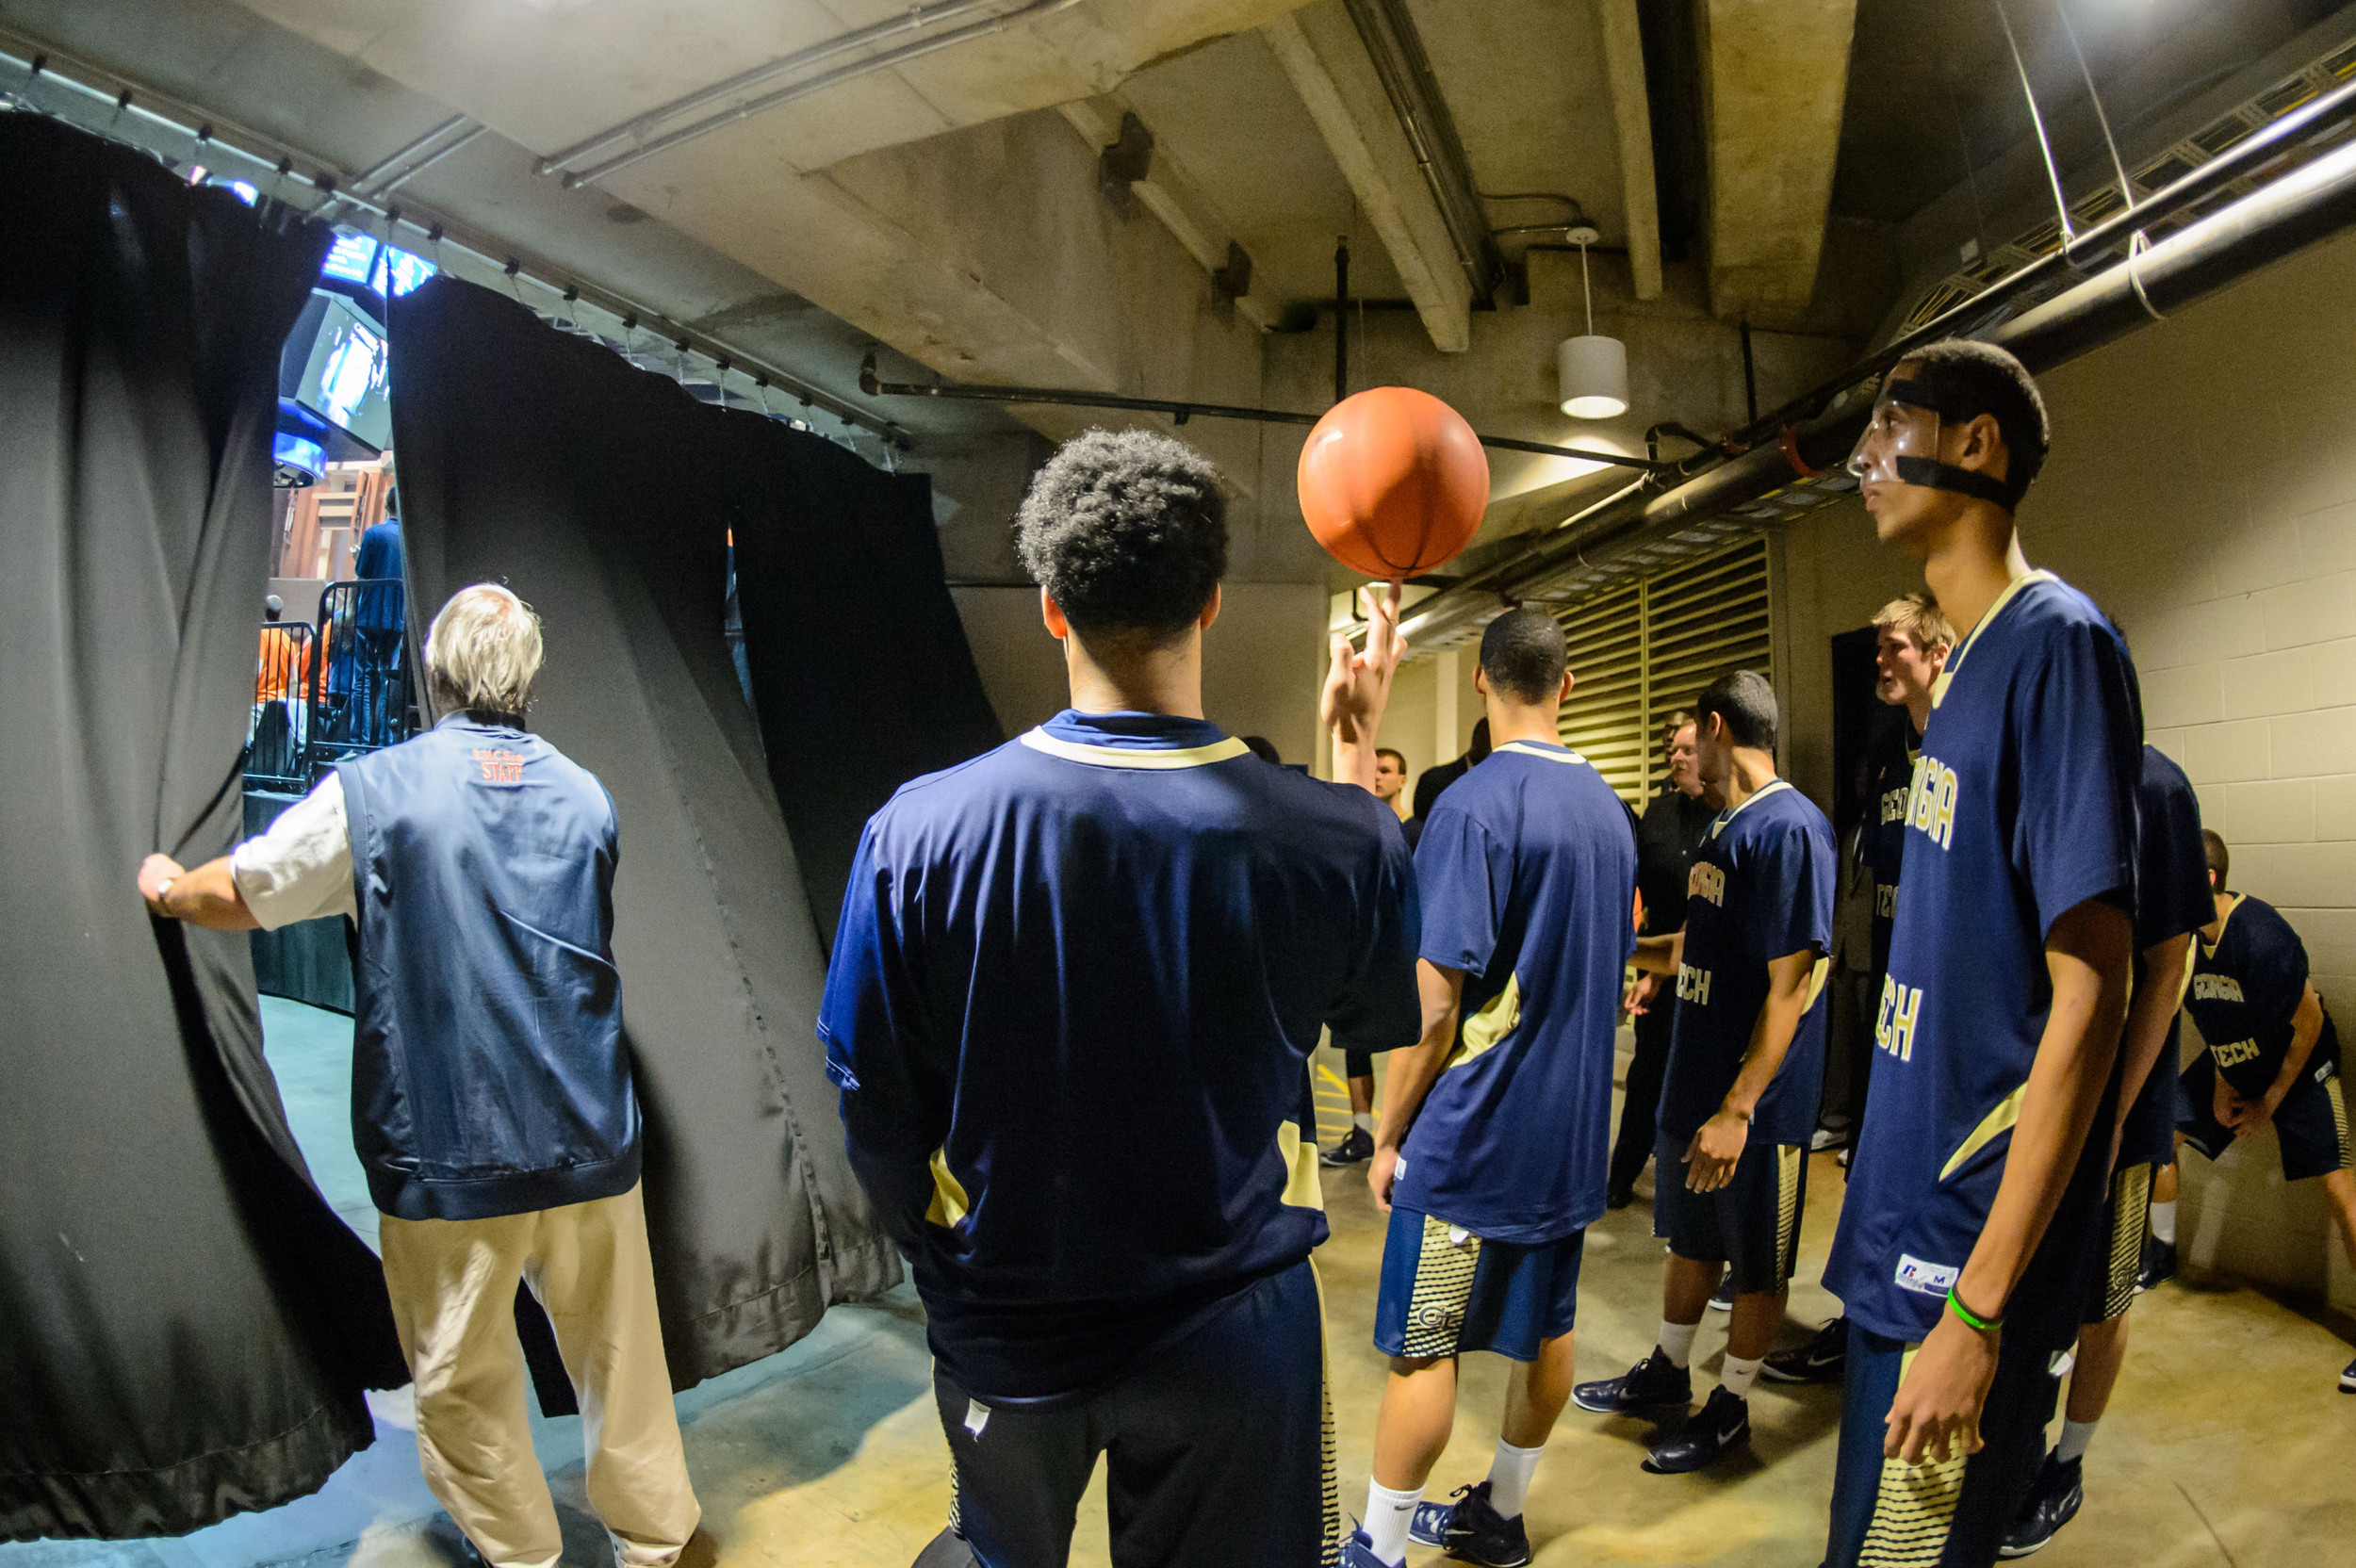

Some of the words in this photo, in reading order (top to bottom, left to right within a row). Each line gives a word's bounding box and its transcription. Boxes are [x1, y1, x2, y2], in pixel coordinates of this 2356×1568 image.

[1881, 787, 1909, 825] GEO
[1676, 961, 1711, 1005] ECH
[2210, 1037, 2260, 1068] TECH
[1933, 1275, 1946, 1284] M
